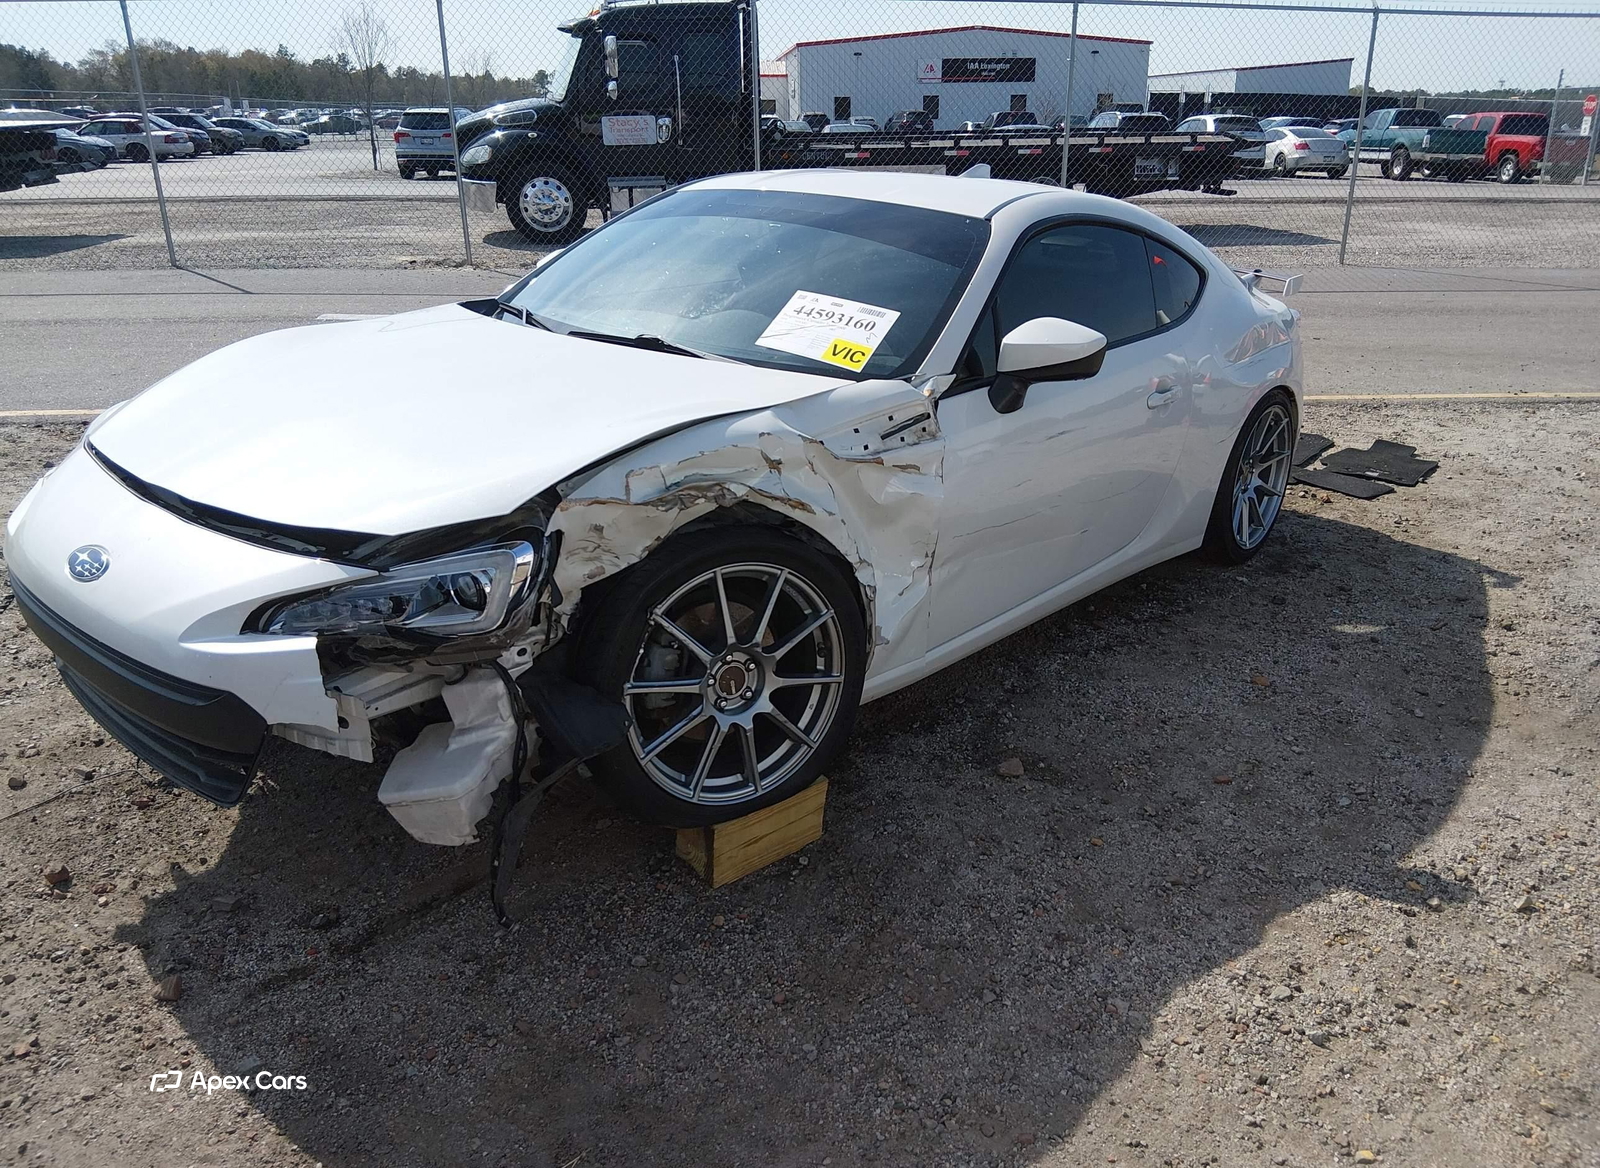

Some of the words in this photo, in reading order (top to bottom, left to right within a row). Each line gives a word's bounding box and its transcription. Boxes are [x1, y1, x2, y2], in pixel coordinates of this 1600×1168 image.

[968, 62, 979, 70] IAA
[608, 118, 649, 128] Stacy's
[793, 304, 877, 332] 44593160
[831, 343, 866, 364] VIC
